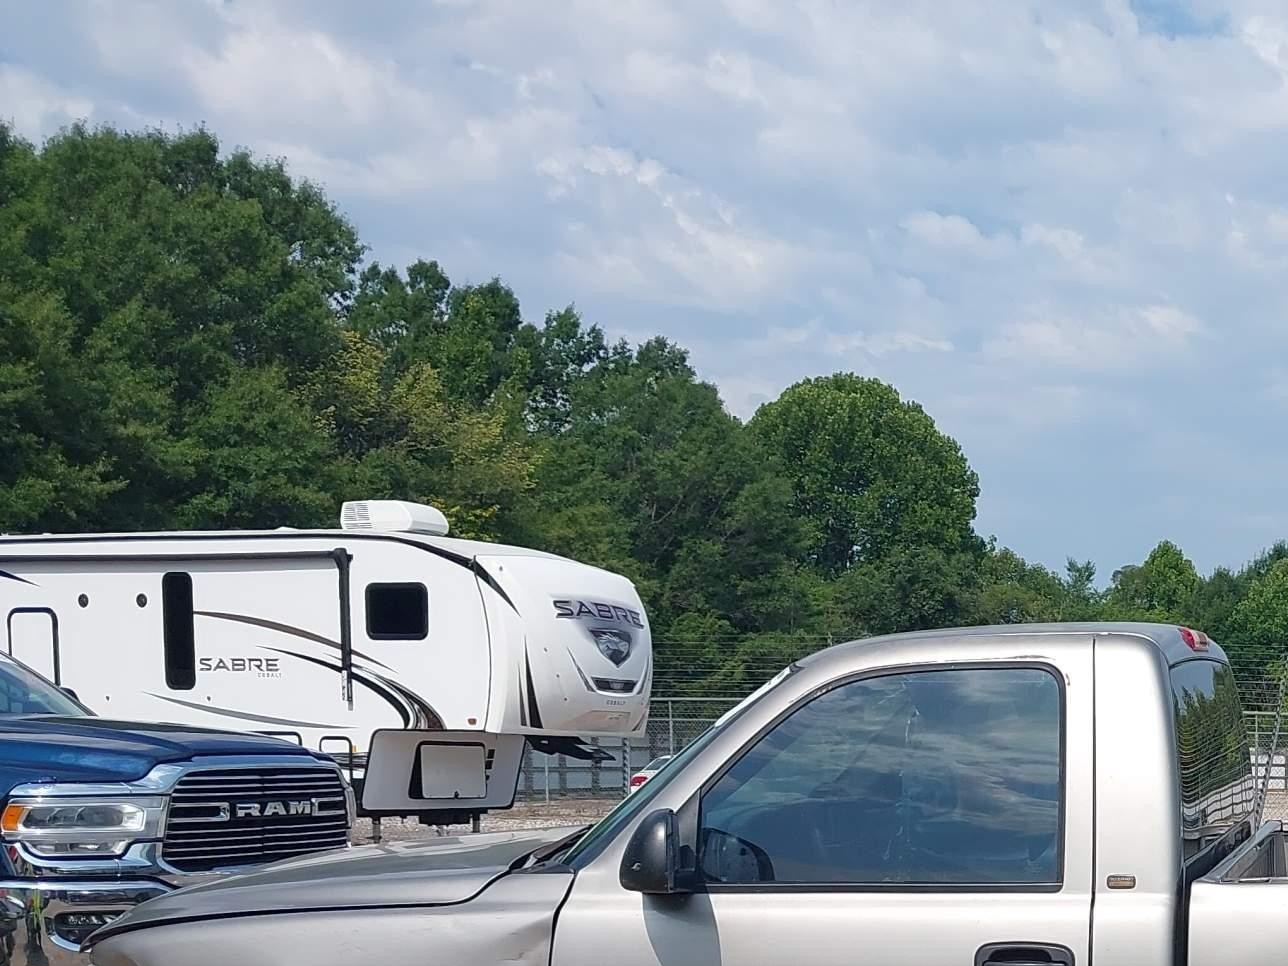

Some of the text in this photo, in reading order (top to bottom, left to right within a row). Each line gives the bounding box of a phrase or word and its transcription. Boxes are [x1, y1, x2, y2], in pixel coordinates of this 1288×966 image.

[553, 600, 645, 629] SABRE
[199, 657, 281, 672] SABRE
[236, 801, 312, 817] RAM
